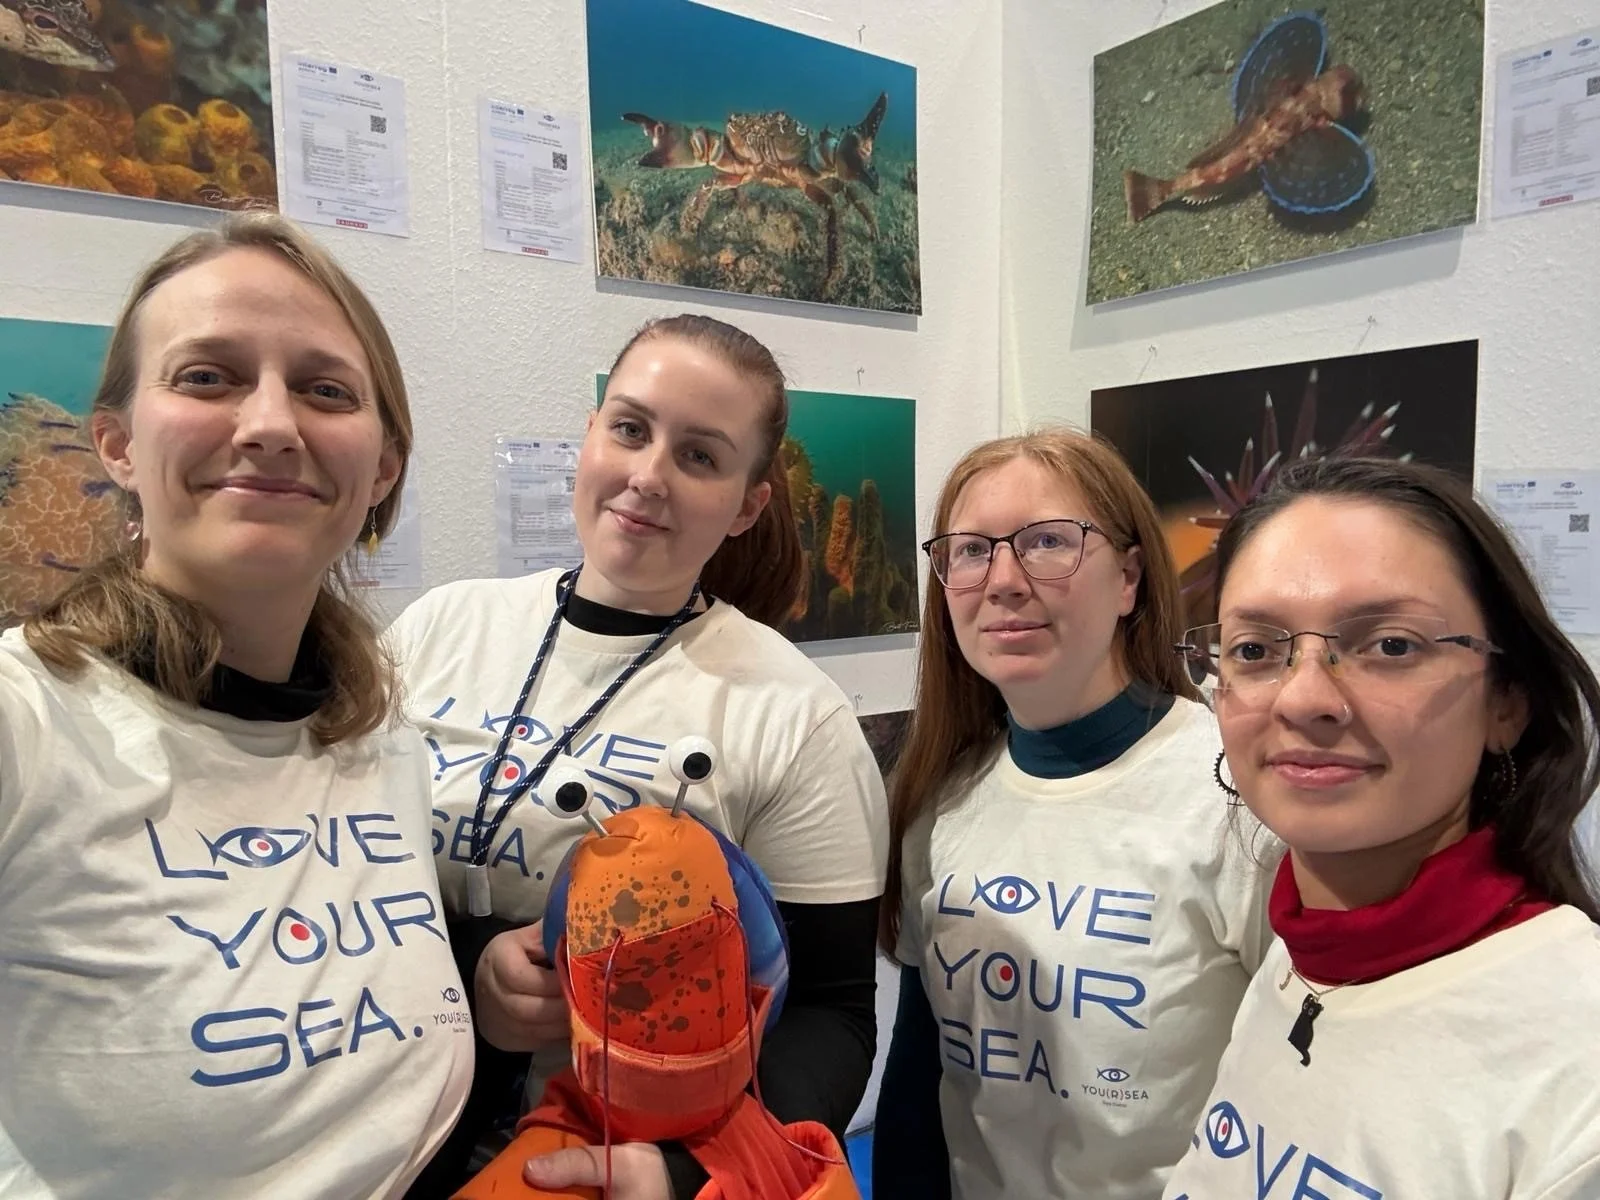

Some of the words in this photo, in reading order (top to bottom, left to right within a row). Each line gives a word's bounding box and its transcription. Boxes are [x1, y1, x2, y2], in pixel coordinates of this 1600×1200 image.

[425, 737, 641, 815] YOR
[145, 814, 415, 880] LOVE
[166, 891, 447, 969] YOUR
[938, 874, 1155, 945] LOVE
[934, 942, 1148, 1029] YOUR
[190, 987, 423, 1087] SEA.
[941, 1018, 1069, 1099] SEA.
